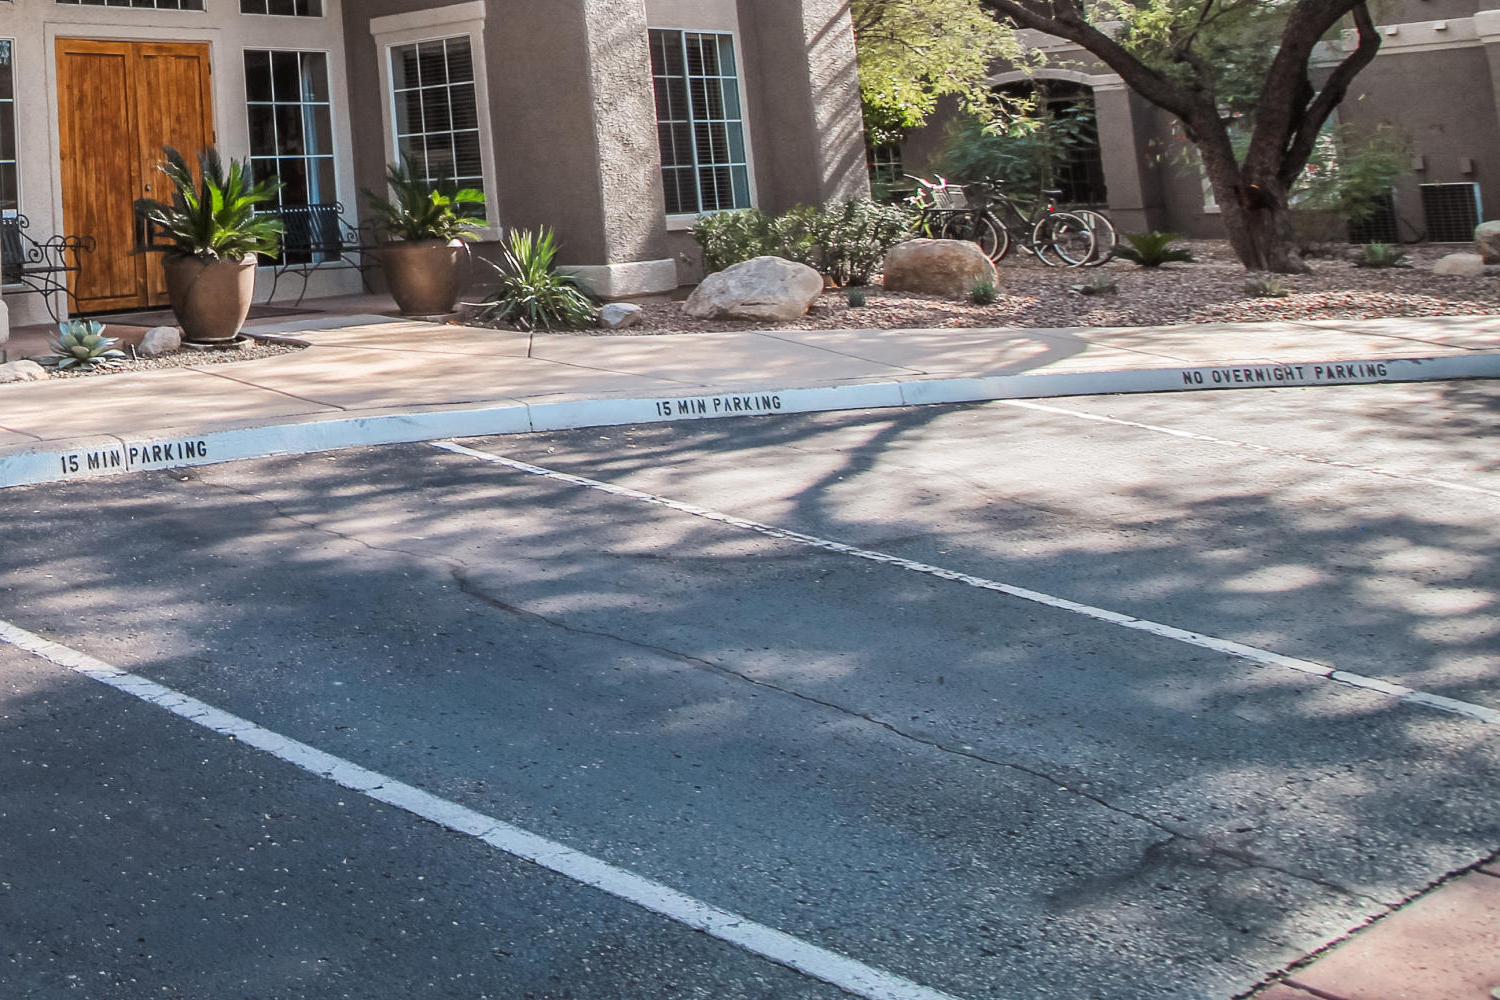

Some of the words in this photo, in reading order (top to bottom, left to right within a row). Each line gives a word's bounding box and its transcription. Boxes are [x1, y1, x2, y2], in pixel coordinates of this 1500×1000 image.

[1182, 371, 1204, 385] NO
[1212, 366, 1304, 384] OVERNIGHT
[1315, 363, 1388, 380] PARKING
[656, 401, 672, 417] 15
[678, 399, 706, 415] MIN
[712, 395, 781, 413] PARKING
[60, 454, 79, 474] 15
[87, 450, 120, 470] MIN
[129, 440, 208, 465] PARKING
